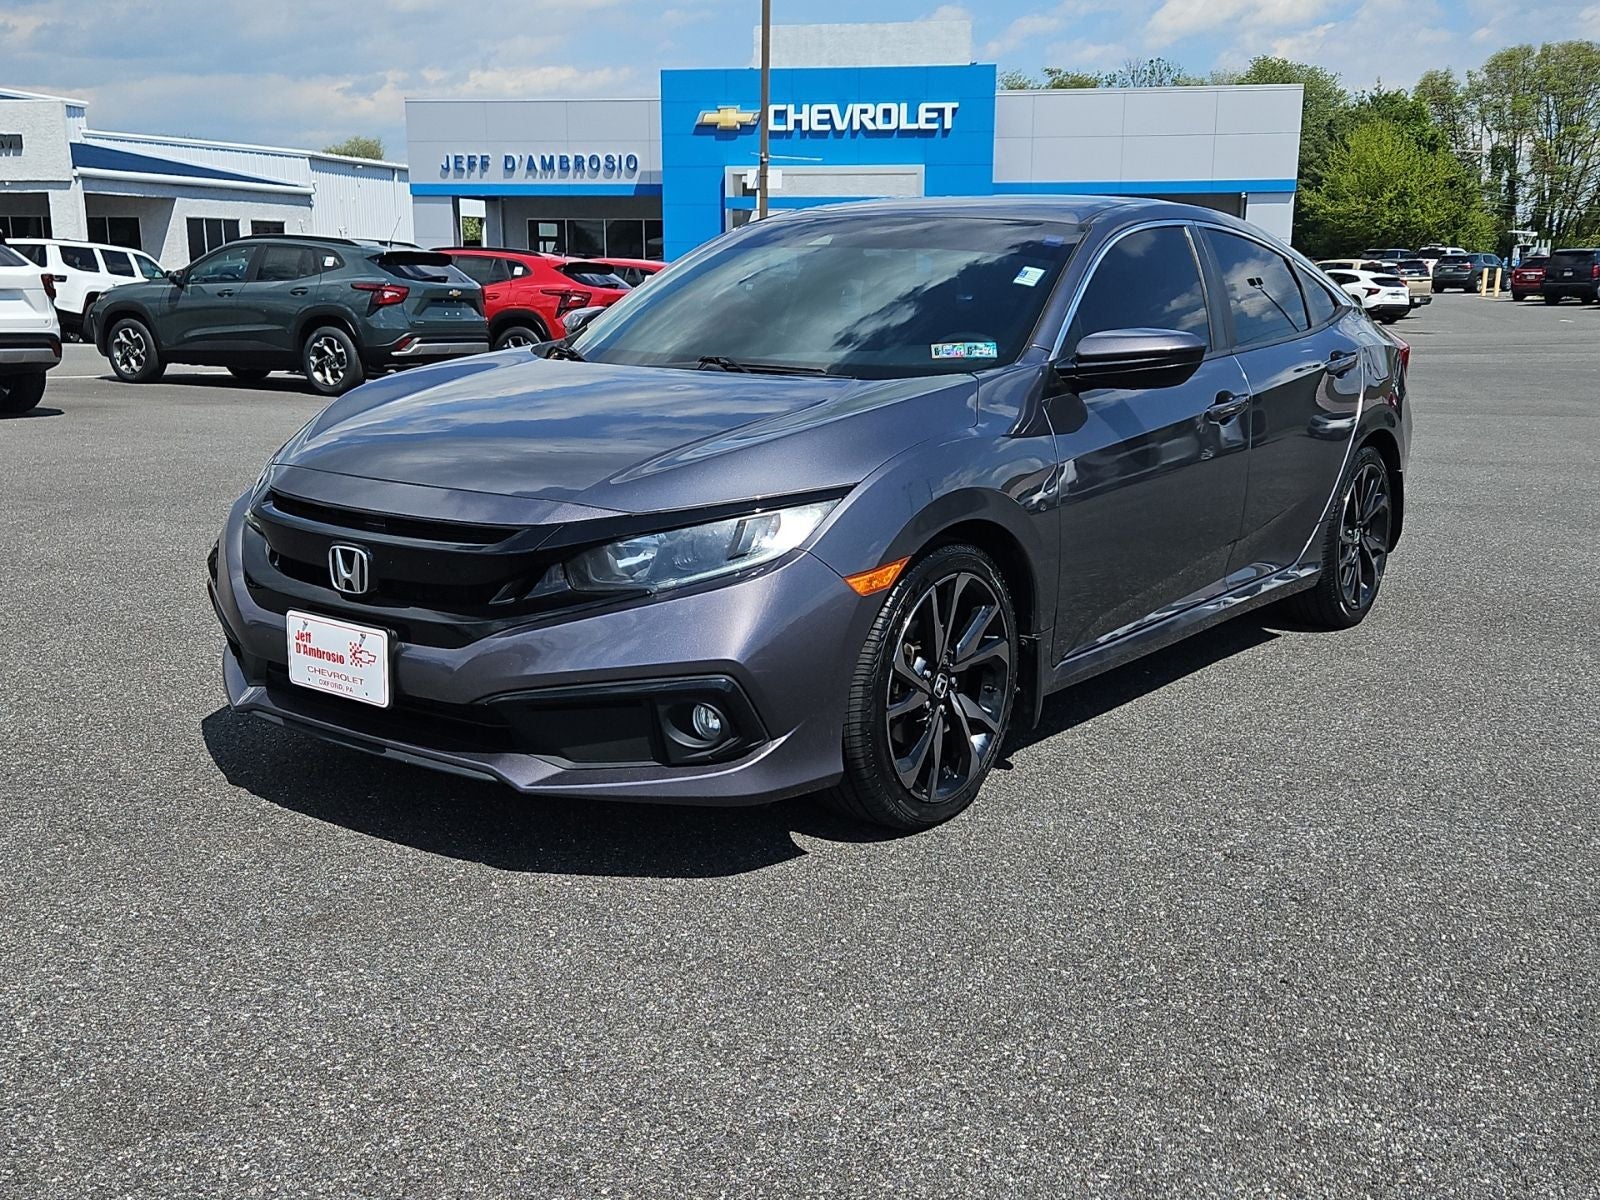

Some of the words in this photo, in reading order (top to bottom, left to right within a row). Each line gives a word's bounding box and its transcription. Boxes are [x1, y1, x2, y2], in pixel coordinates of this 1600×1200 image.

[768, 101, 959, 132] CHEVROLET
[440, 153, 491, 172] JEFF
[504, 152, 639, 172] D'AMBROSIO
[294, 629, 312, 644] Jeff
[295, 642, 345, 665] D'Ambrosio
[307, 665, 365, 686] CHEVROLET
